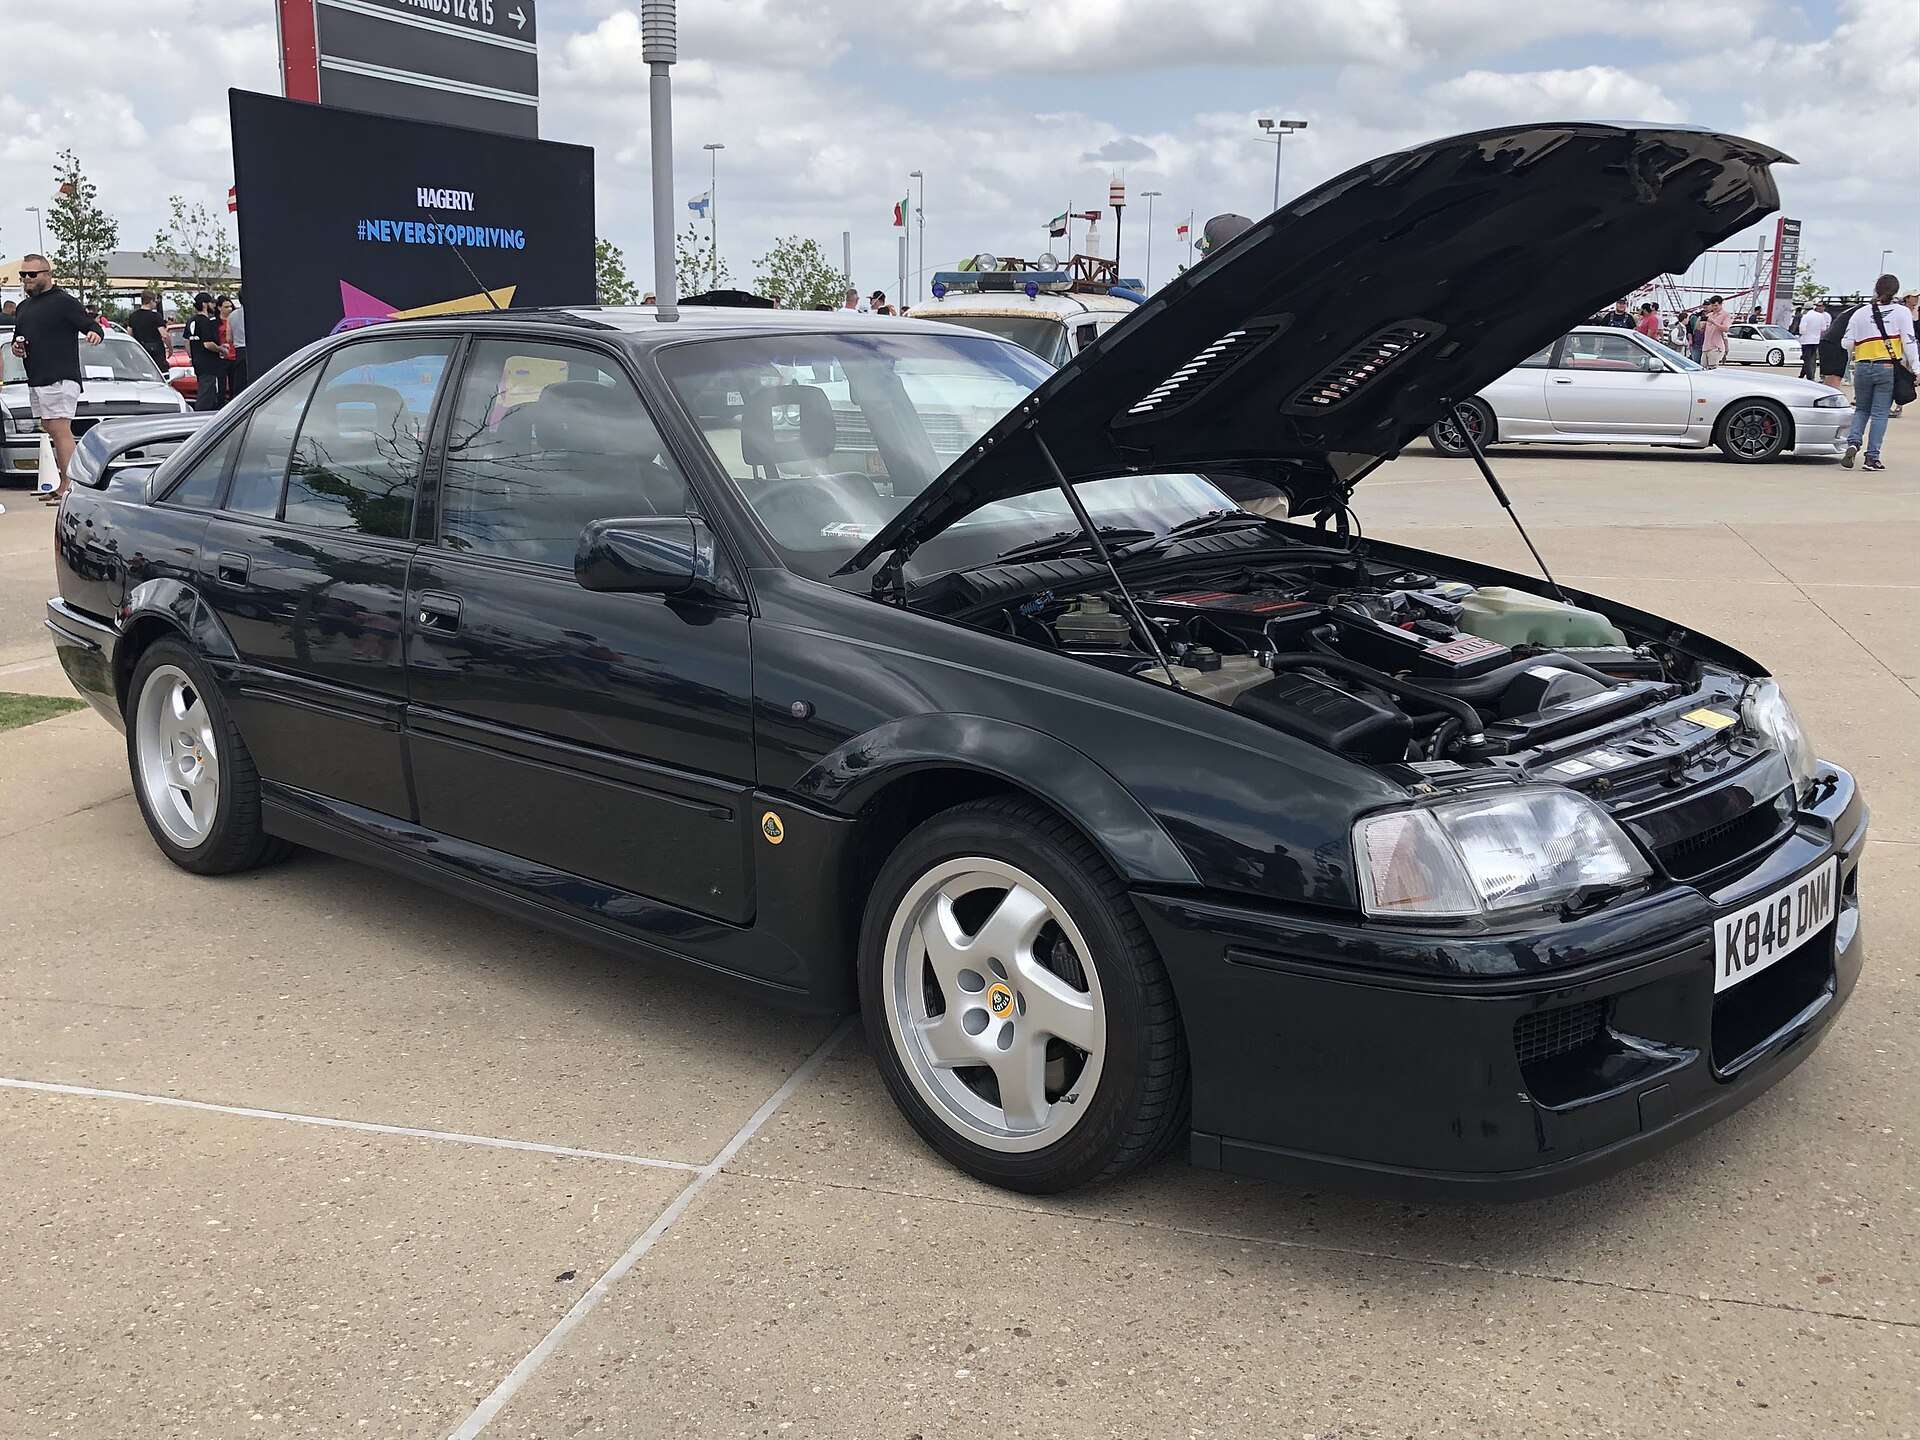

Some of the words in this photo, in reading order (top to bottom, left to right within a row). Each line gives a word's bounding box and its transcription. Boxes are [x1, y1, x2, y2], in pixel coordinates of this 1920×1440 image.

[481, 0, 494, 25] 15
[417, 187, 474, 211] HAGERTY
[357, 219, 525, 250] #NEVERSTOPDRIVING
[1725, 895, 1791, 977] K848
[1796, 867, 1831, 937] DNM
